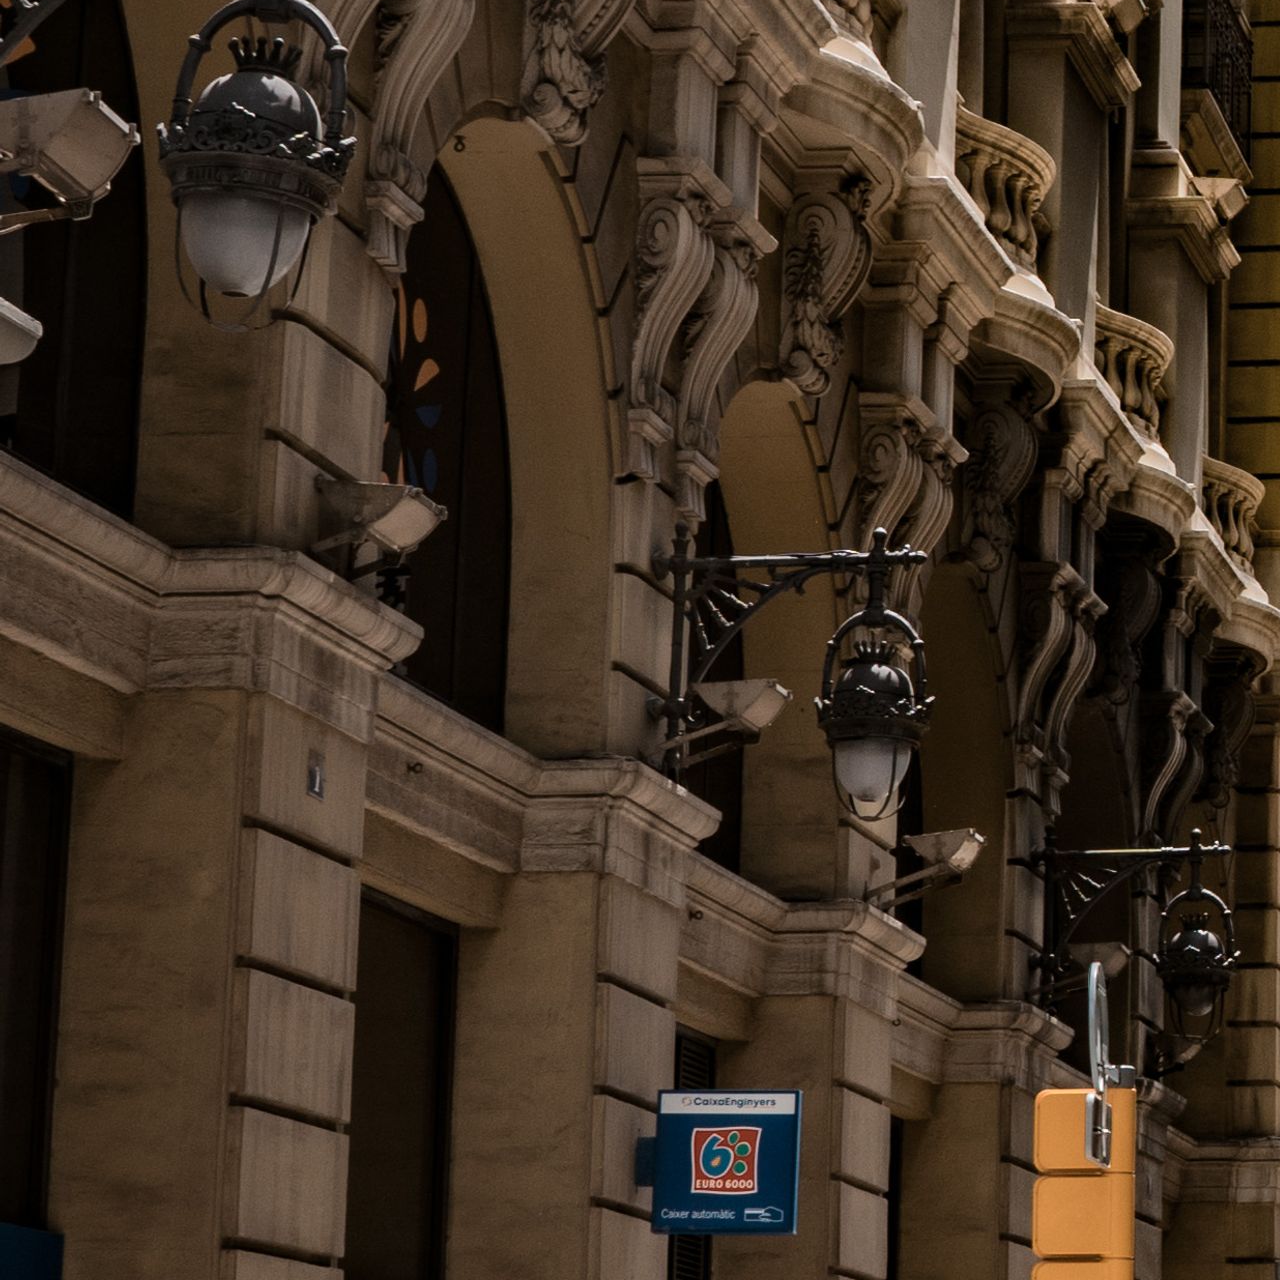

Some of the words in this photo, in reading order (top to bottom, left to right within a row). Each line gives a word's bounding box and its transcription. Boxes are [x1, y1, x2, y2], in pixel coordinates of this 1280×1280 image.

[693, 1097, 776, 1108] CaixaEnginyers
[695, 1179, 723, 1189] EURO
[725, 1179, 754, 1189] 6000
[660, 1208, 690, 1220] Caixer
[691, 1208, 736, 1220] automàtic
